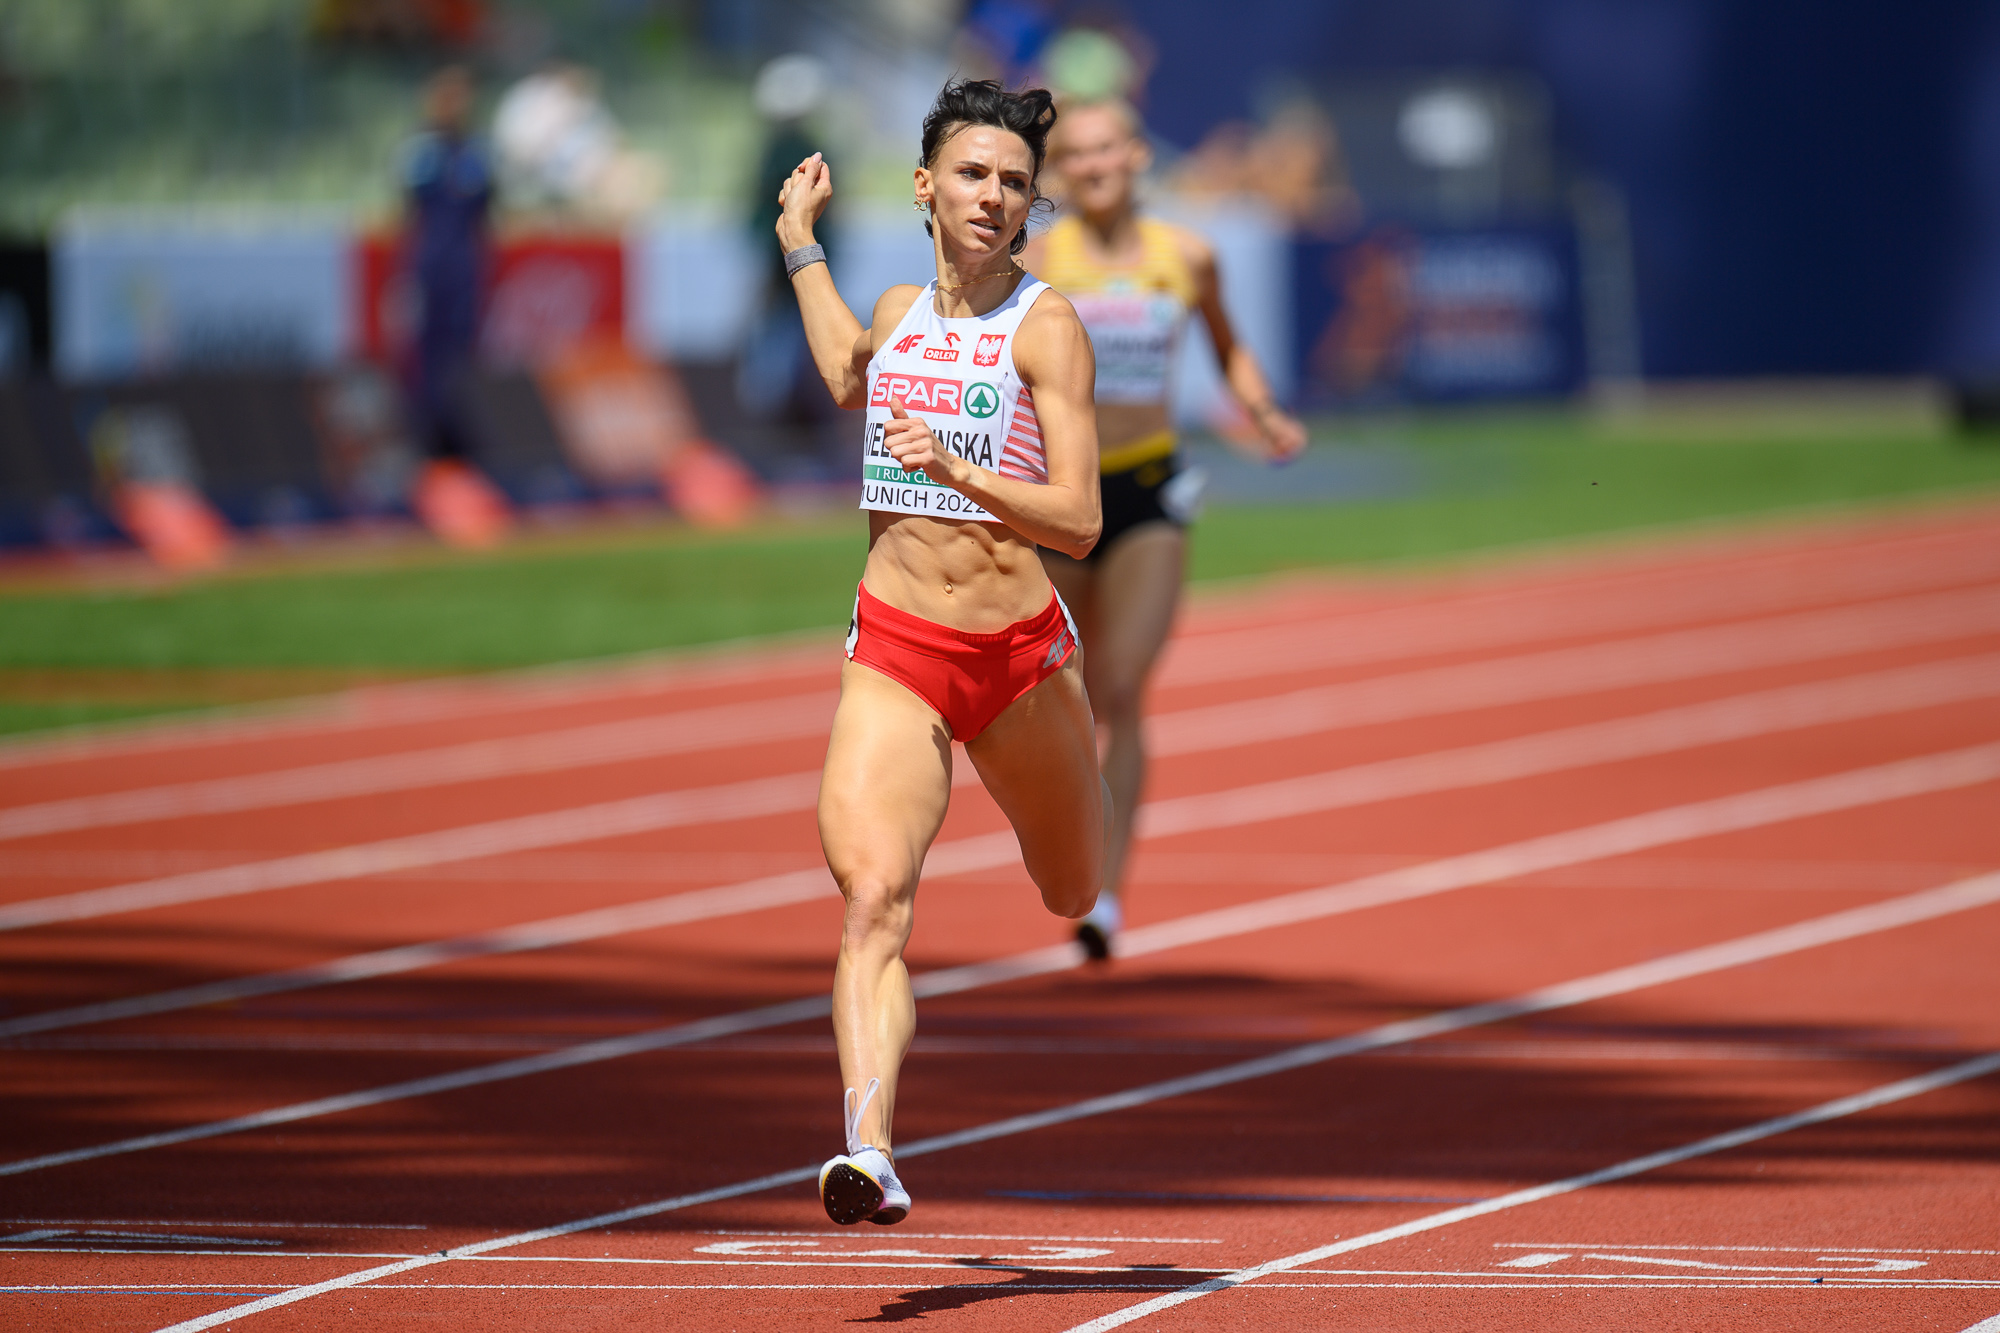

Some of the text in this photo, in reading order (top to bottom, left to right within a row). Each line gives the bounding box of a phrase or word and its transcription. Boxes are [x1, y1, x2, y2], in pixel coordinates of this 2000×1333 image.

[925, 350, 957, 361] ORLEN
[872, 377, 959, 410] SPAR
[876, 467, 880, 478] I
[883, 468, 910, 483] RUN
